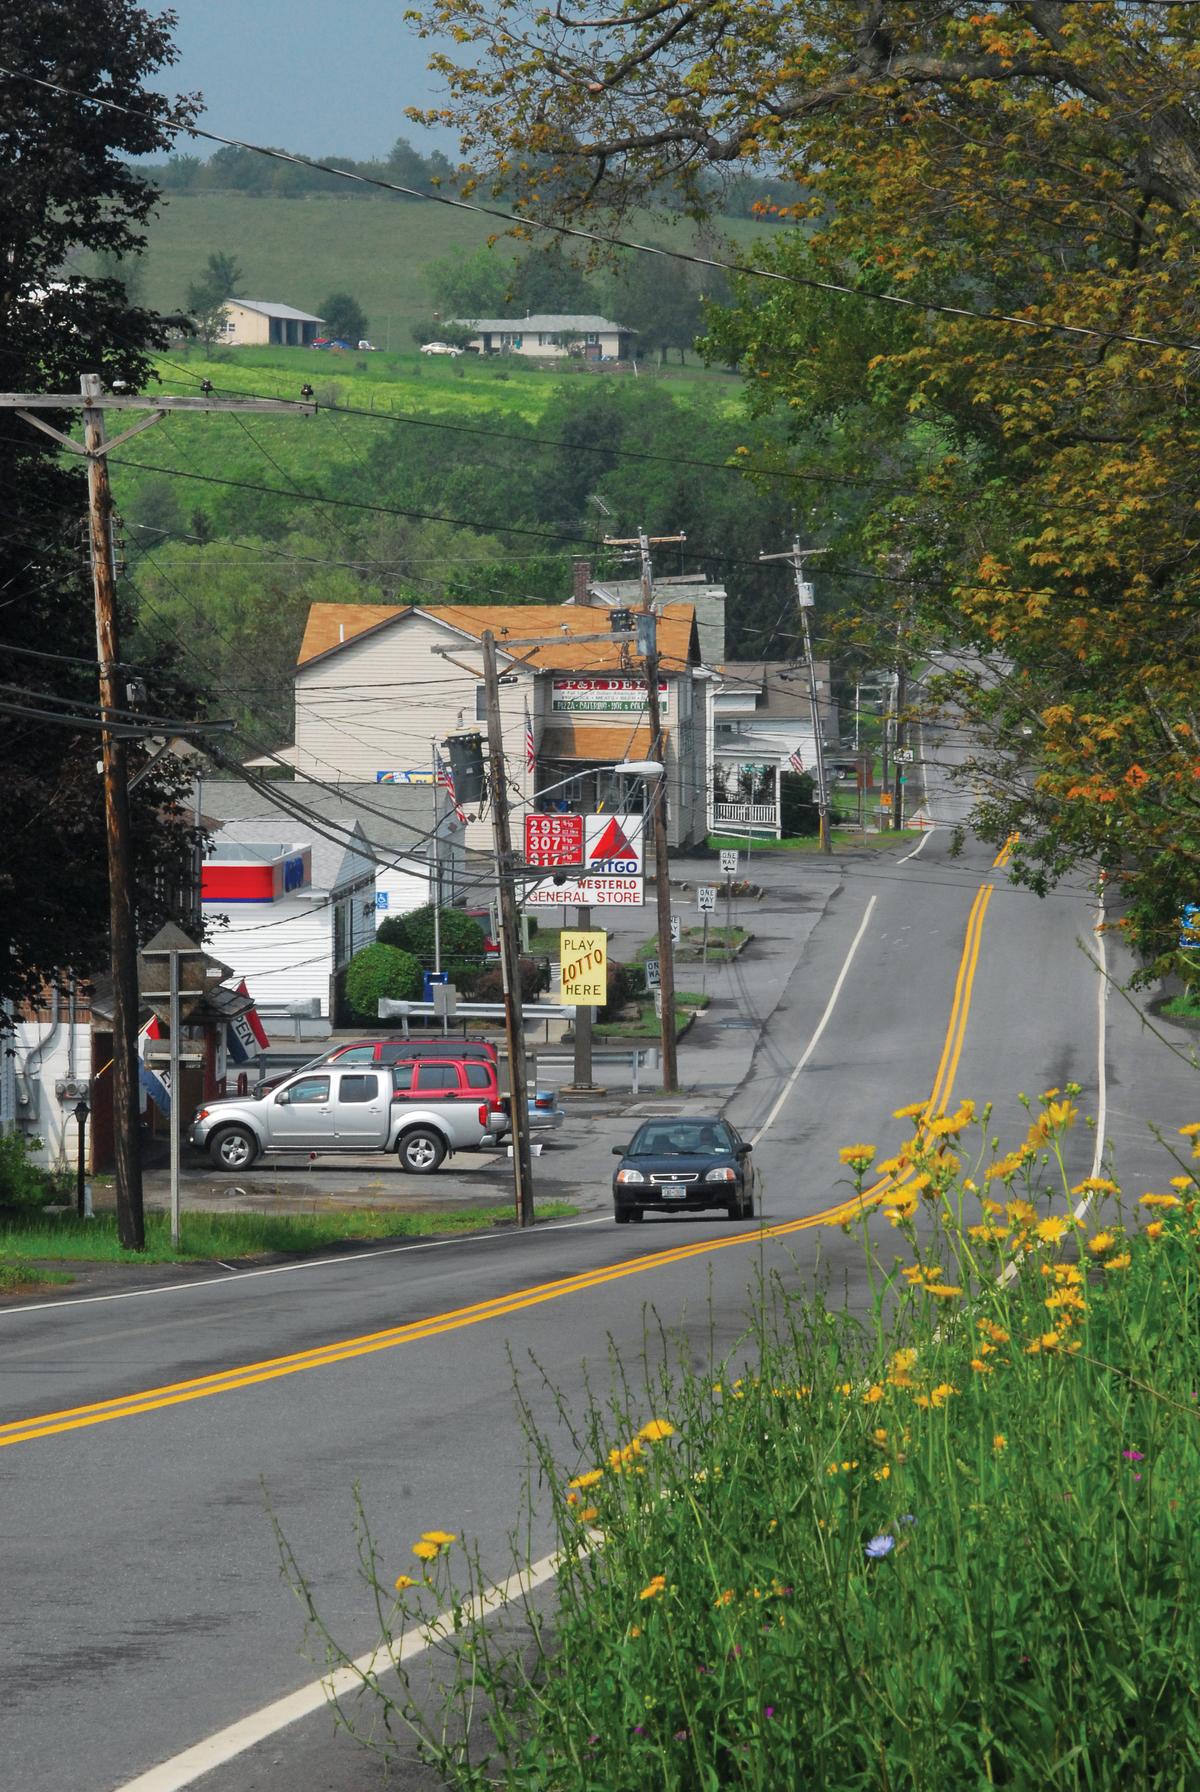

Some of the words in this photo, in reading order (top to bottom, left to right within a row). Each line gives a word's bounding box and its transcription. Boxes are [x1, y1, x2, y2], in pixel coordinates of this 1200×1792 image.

[608, 680, 646, 690] DEL
[577, 880, 636, 890] WESTERLO
[529, 892, 588, 902] GENERAL
[597, 892, 640, 903] STORE
[564, 940, 595, 951] PLAY
[562, 949, 603, 986] LOTTO
[648, 962, 659, 970] ON
[566, 984, 601, 995] HERE
